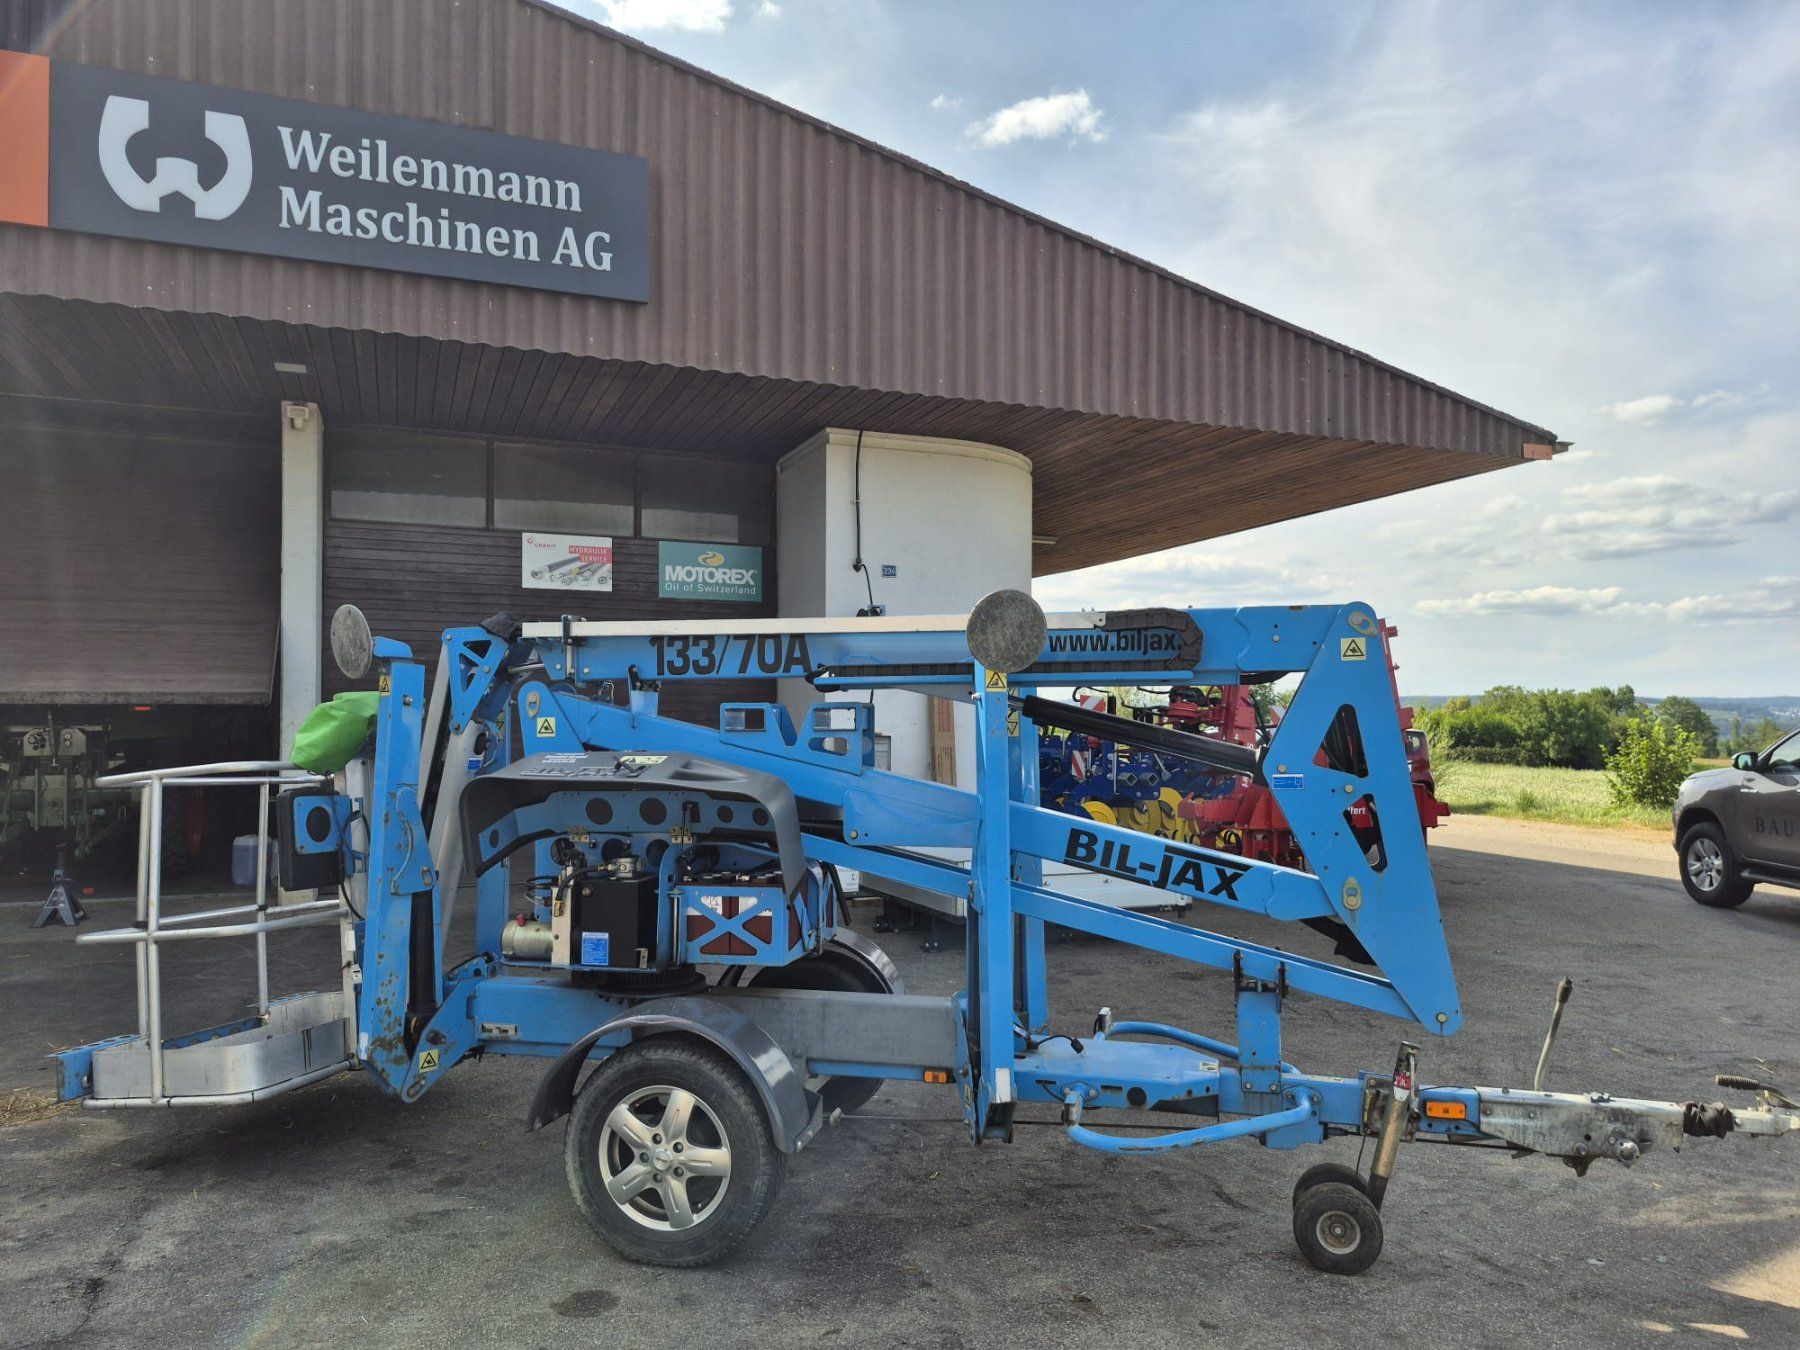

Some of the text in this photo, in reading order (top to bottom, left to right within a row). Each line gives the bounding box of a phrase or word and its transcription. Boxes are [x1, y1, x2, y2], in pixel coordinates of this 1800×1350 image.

[277, 125, 583, 213] Weilenmann
[279, 185, 614, 272] Maschinen AG
[581, 554, 607, 563] SERVICE
[665, 565, 755, 586] MOTOREX
[665, 582, 756, 595] Oil of Switzerland
[649, 633, 812, 676] 133/70A
[1064, 828, 1248, 901] BIL-JAX
